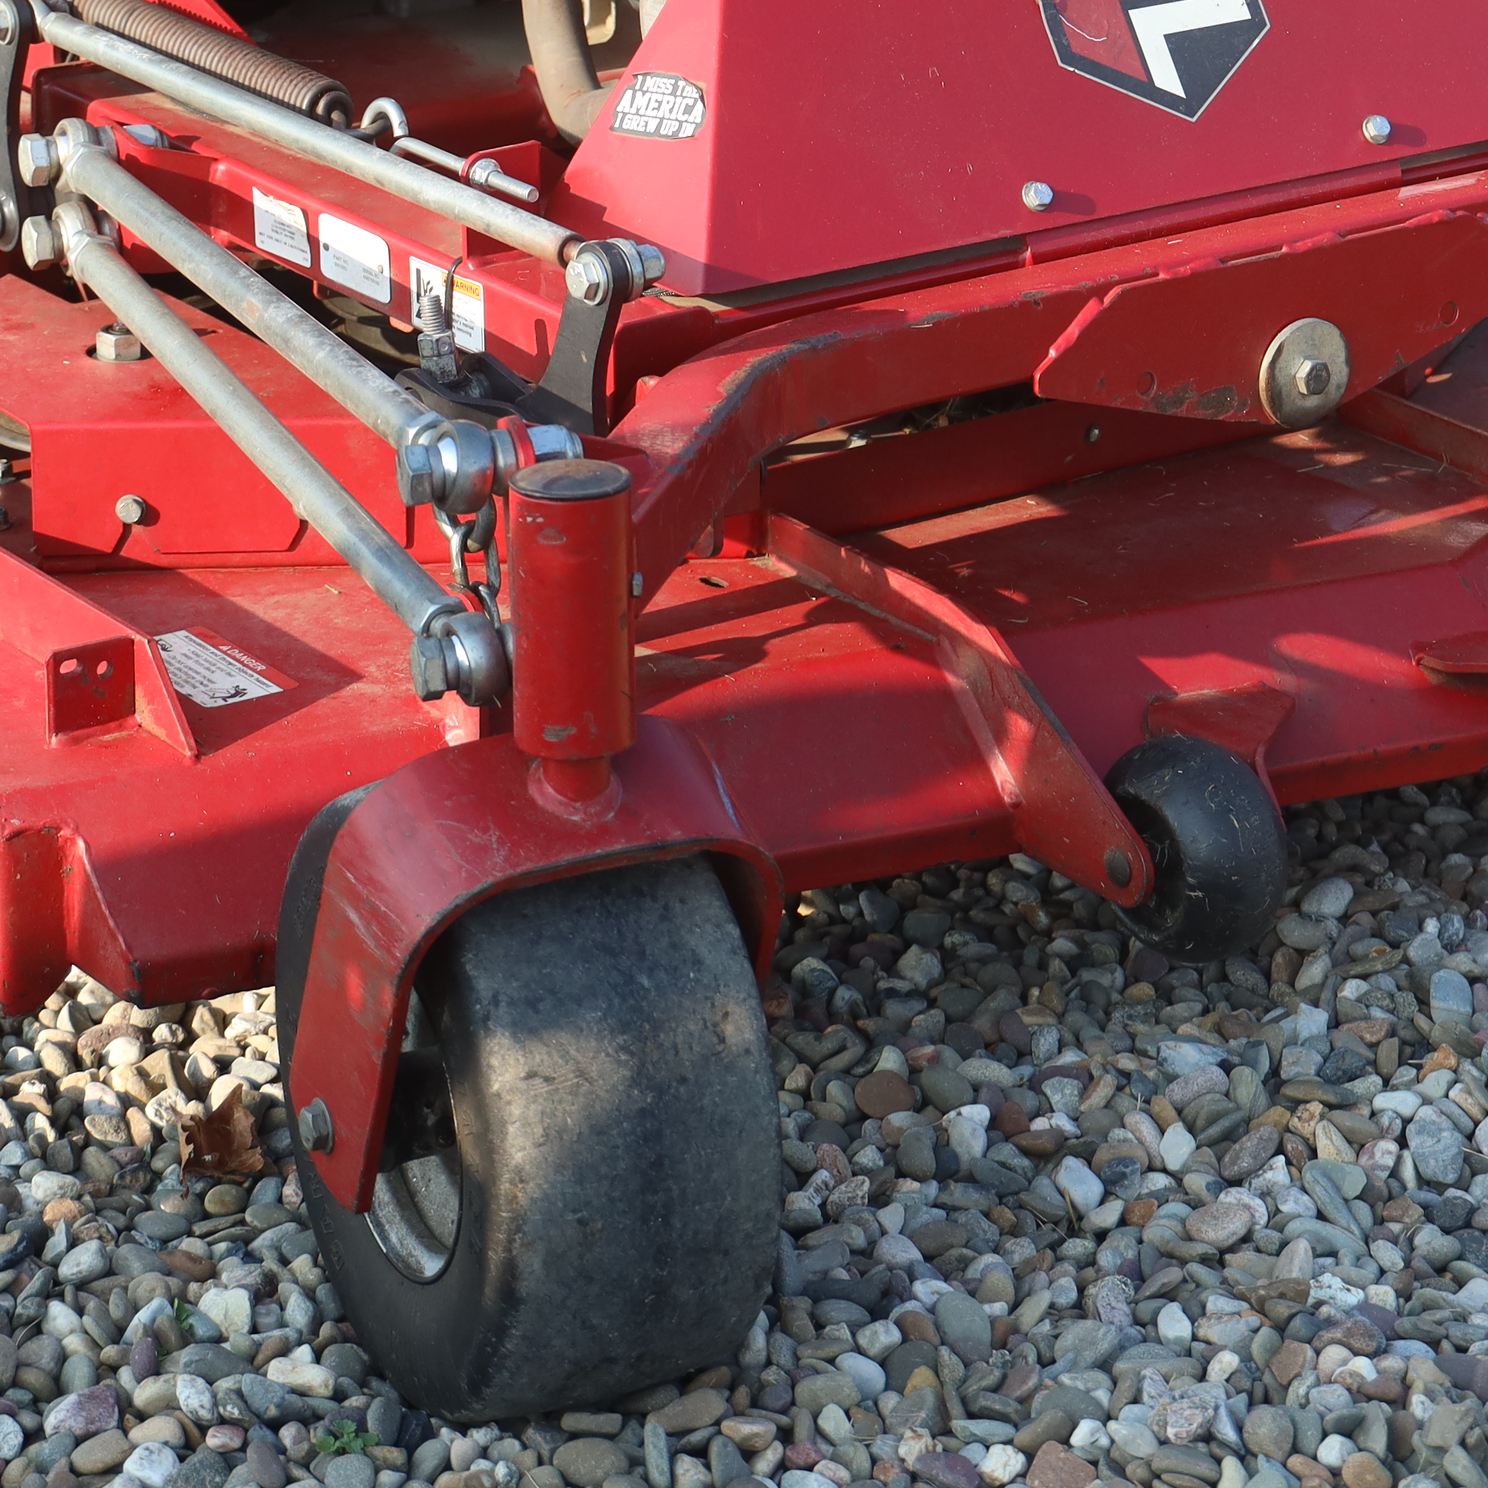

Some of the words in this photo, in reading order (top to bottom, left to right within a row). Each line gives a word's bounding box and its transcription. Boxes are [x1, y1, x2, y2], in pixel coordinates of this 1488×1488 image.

[635, 75, 643, 90] I
[643, 76, 675, 96] MISS
[616, 89, 704, 123] AMERICA
[614, 113, 623, 128] I
[622, 114, 661, 134] GREW
[659, 119, 680, 136] UP
[678, 123, 696, 138] IN
[455, 281, 480, 296] ARNING
[227, 649, 267, 672] DANGER
